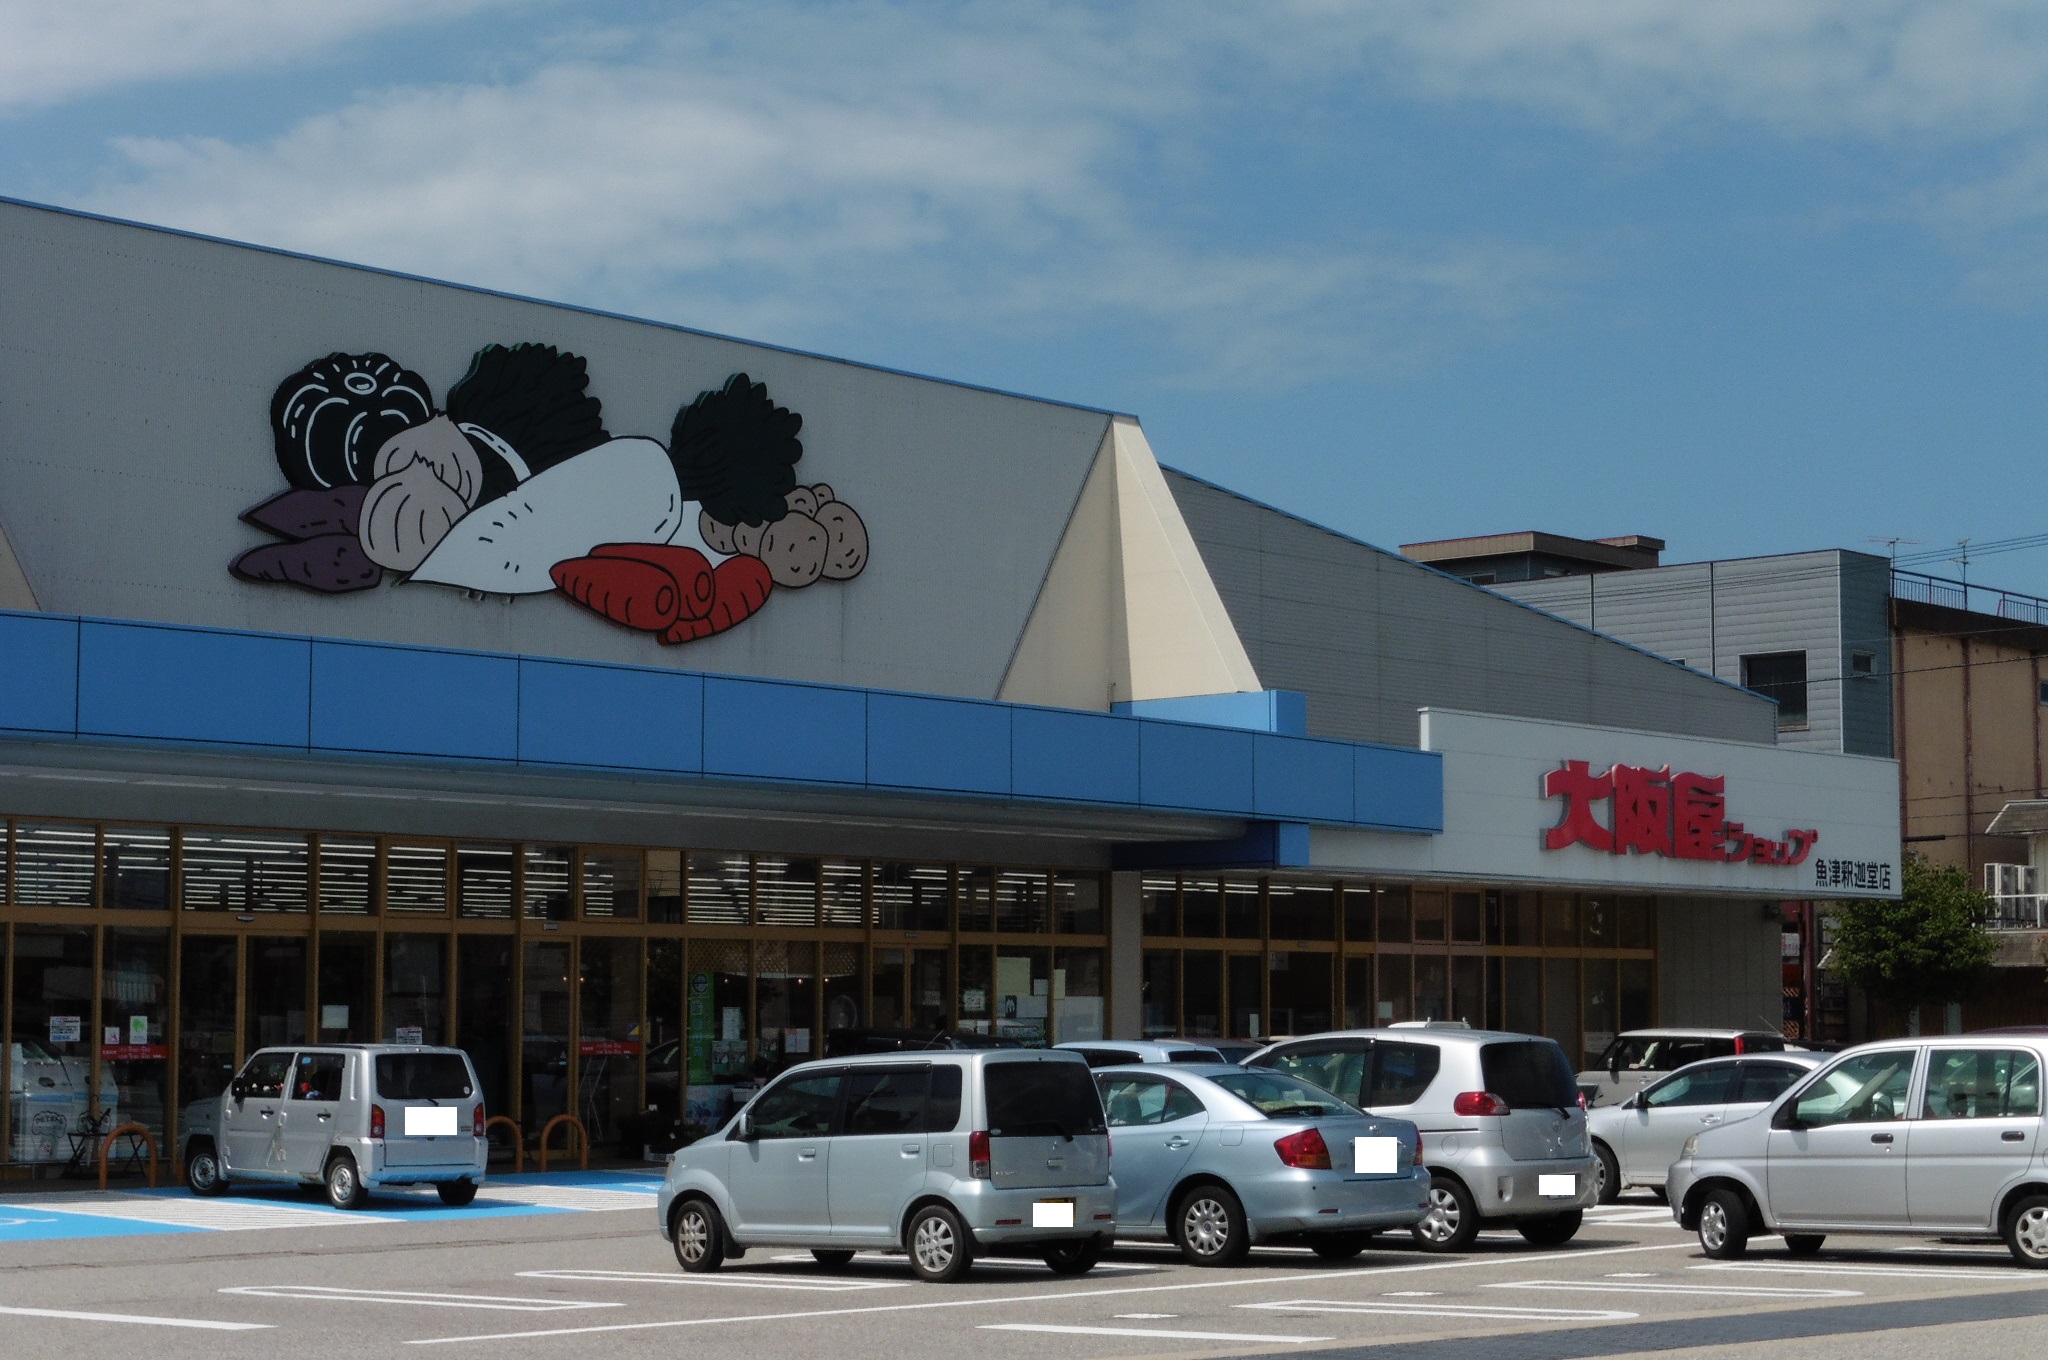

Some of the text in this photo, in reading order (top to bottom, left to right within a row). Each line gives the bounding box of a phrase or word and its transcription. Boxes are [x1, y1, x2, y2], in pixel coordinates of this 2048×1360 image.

[1543, 759, 1818, 865] 大阪屋ショップ
[1814, 857, 1891, 891] 魚津釈迦堂店
